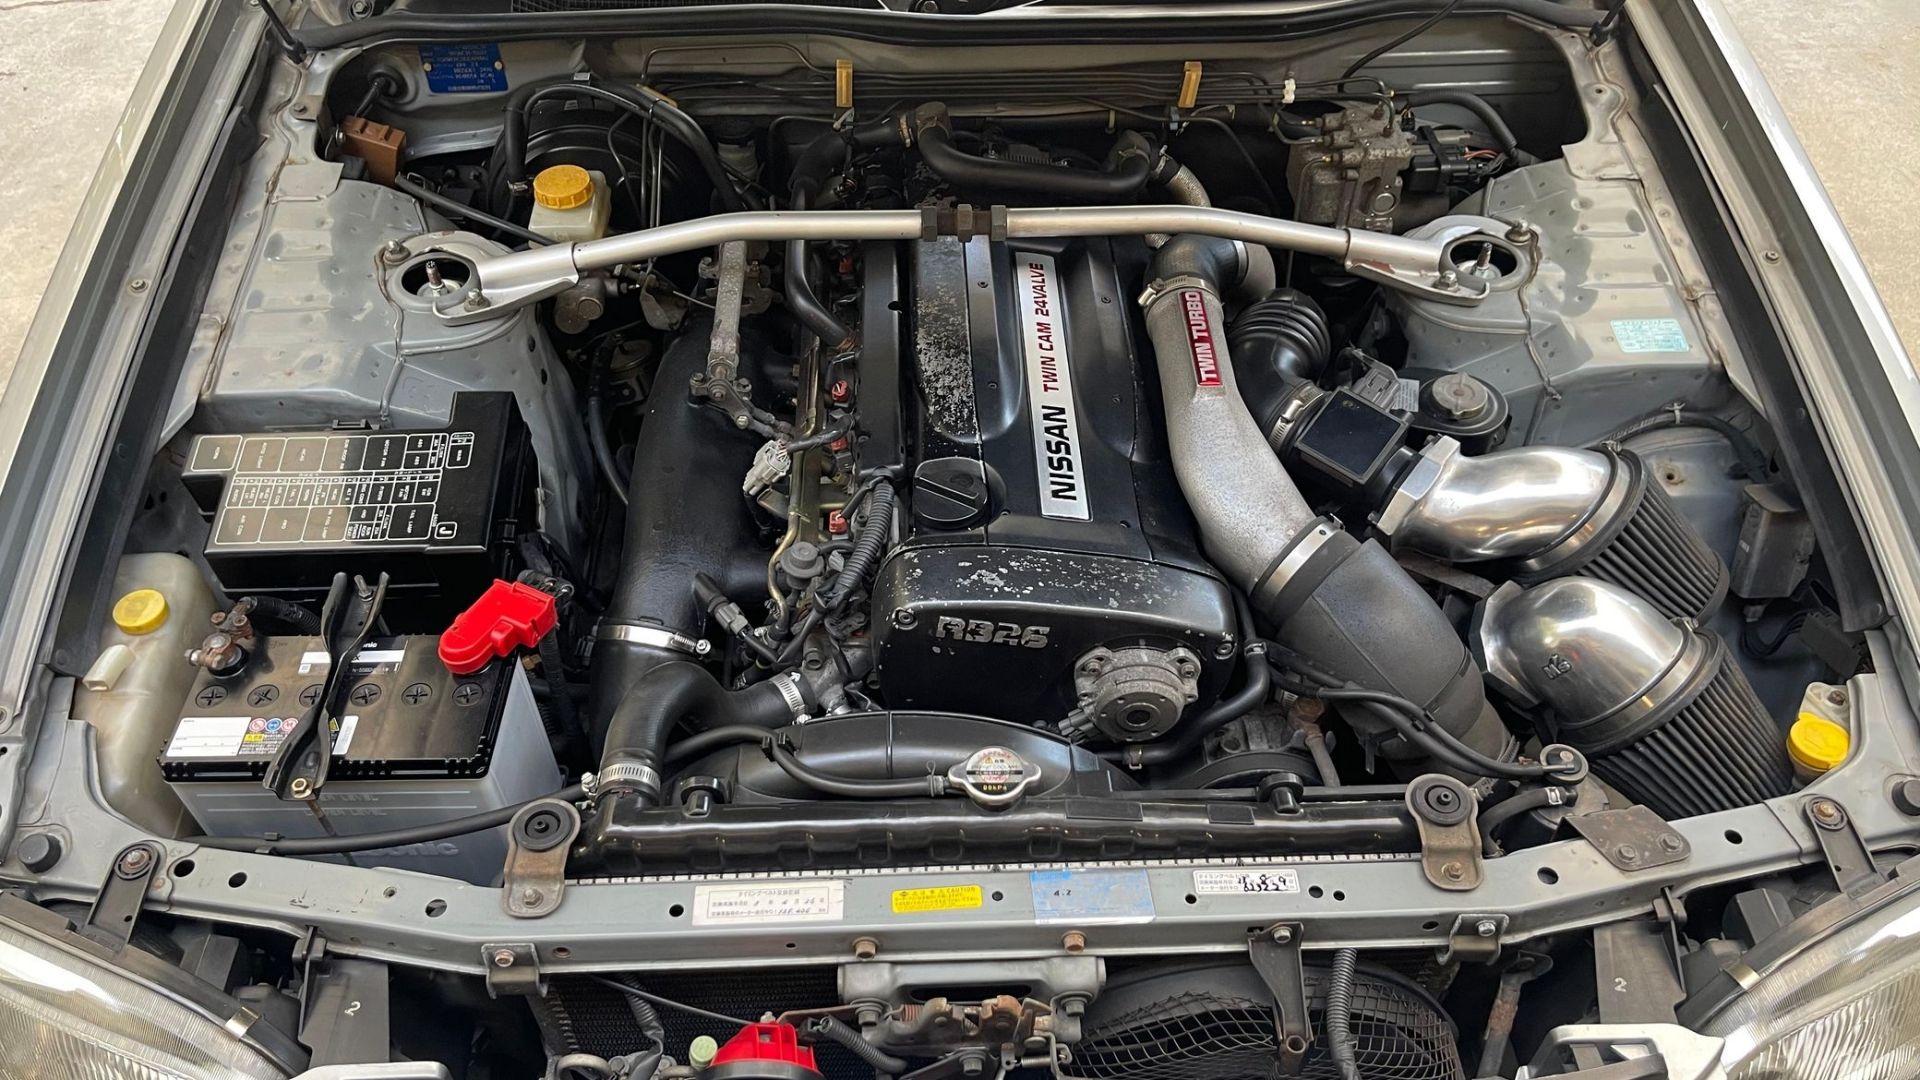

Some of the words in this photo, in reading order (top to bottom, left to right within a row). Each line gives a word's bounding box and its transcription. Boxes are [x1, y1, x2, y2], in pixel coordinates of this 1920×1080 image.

[1029, 262, 1050, 318] 24VALVE
[1184, 290, 1209, 341] TURBO
[1035, 321, 1055, 352] CAM
[1040, 356, 1060, 392] TWIN
[1196, 341, 1220, 382] TWIN
[1042, 404, 1077, 501] NISSAN
[936, 616, 1050, 649] RB26
[1614, 977, 1627, 993] 2
[344, 1001, 361, 1016] 2
